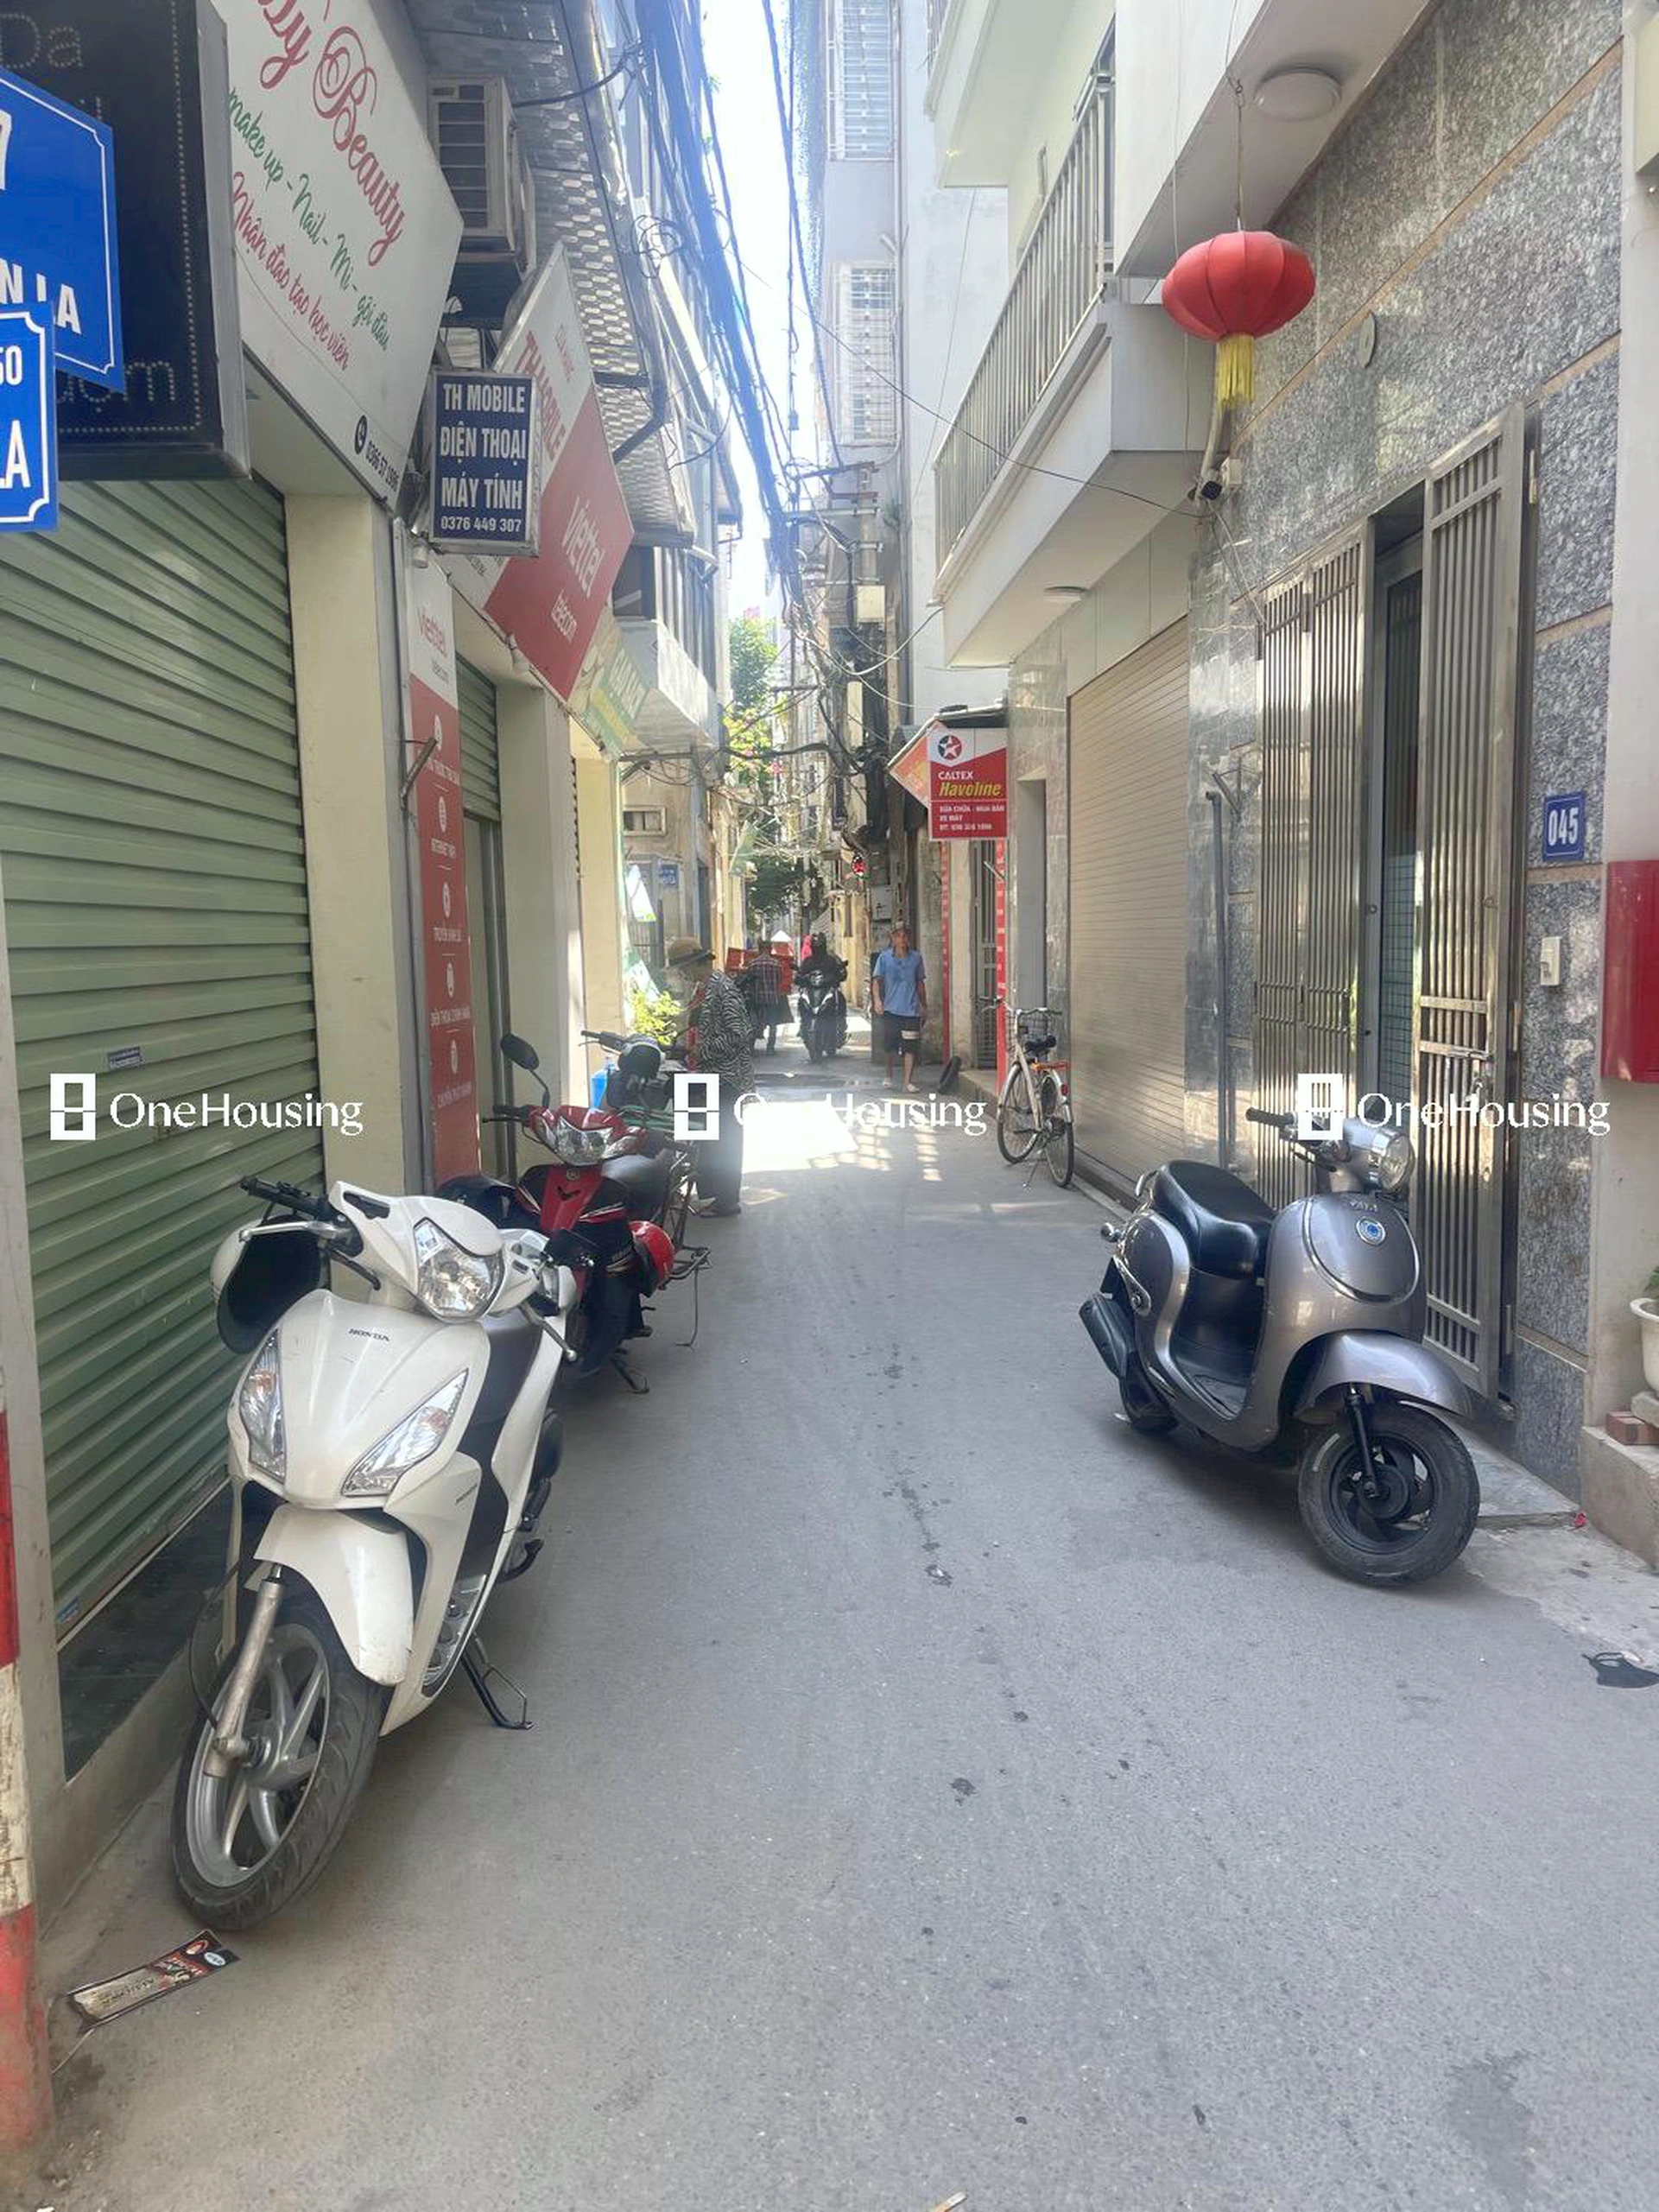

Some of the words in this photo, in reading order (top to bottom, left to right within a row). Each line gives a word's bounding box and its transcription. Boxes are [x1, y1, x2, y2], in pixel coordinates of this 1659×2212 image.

[313, 26, 405, 266] Beauty
[293, 174, 326, 244] Nail
[443, 383, 462, 410] TH
[467, 384, 525, 413] MOBILE
[440, 421, 477, 464] ĐIỆN
[482, 428, 527, 466] THOẠI
[441, 471, 478, 508] MÁY
[484, 472, 522, 510] TÍNH
[440, 516, 471, 531] 0376
[474, 517, 497, 532] 449
[499, 518, 522, 533] 307
[938, 770, 974, 781] CALTEX
[939, 781, 1002, 798] Havoline
[1547, 807, 1580, 846] 045
[348, 1328, 390, 1341] HONDA
